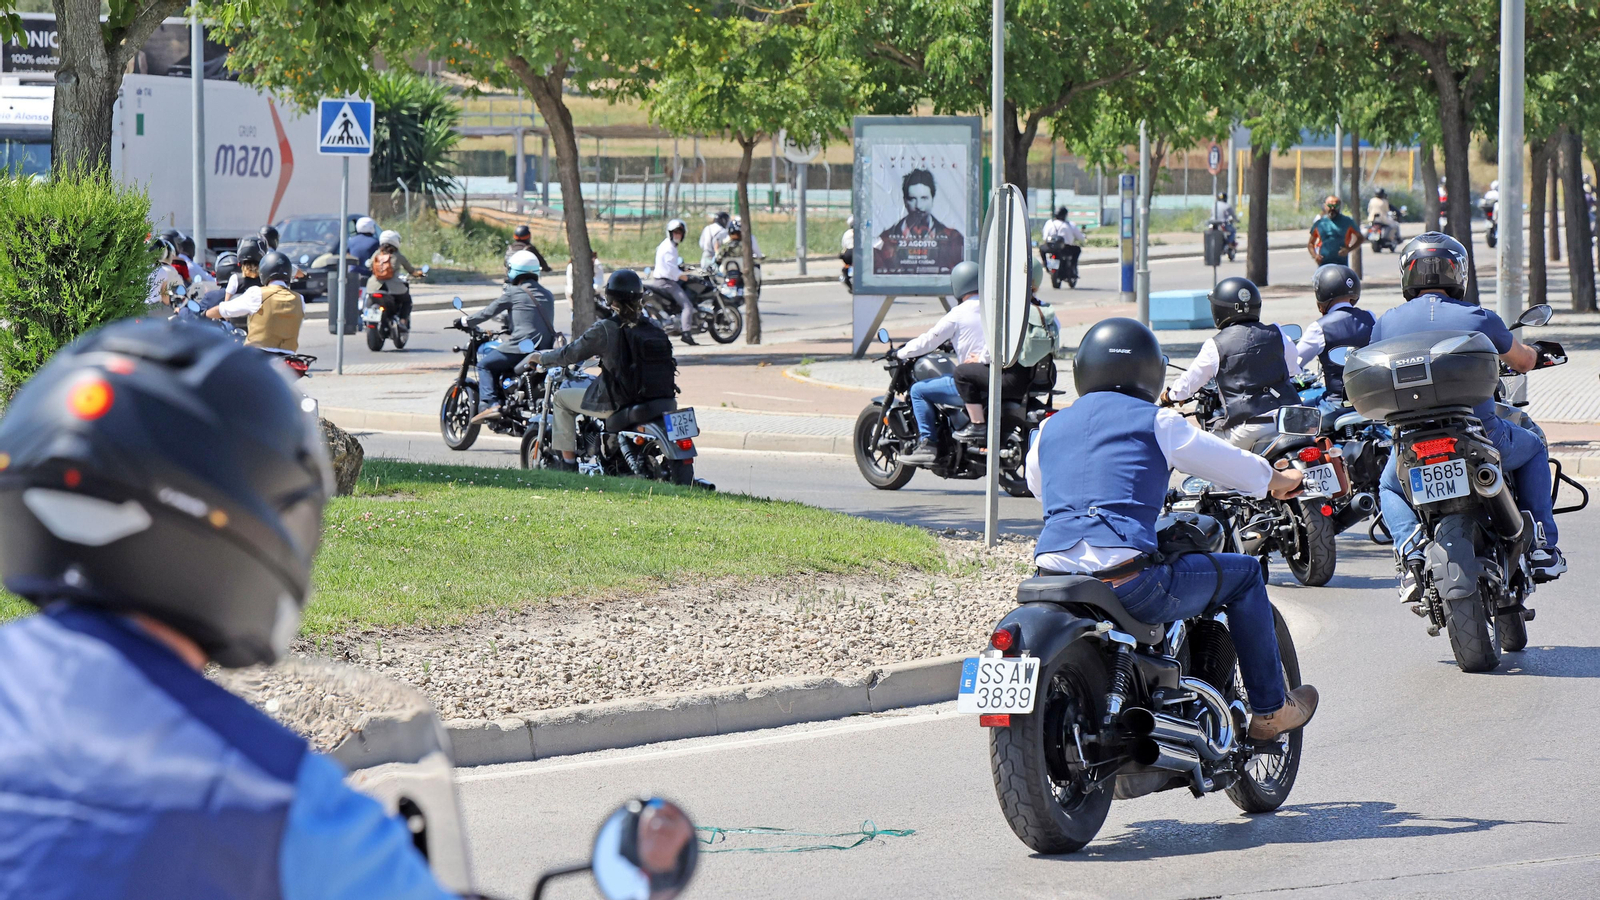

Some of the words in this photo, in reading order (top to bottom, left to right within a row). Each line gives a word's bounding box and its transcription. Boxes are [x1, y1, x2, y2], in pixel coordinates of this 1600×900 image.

[11, 53, 35, 65] 100%
[14, 112, 49, 121] Alonso
[214, 144, 273, 178] mazo
[1395, 356, 1425, 366] SHAD
[672, 413, 693, 427] 2254
[675, 425, 690, 437] JNF
[1423, 462, 1463, 482] 5685
[1425, 480, 1456, 499] KRM
[965, 679, 972, 688] E
[977, 687, 1031, 708] 3839
